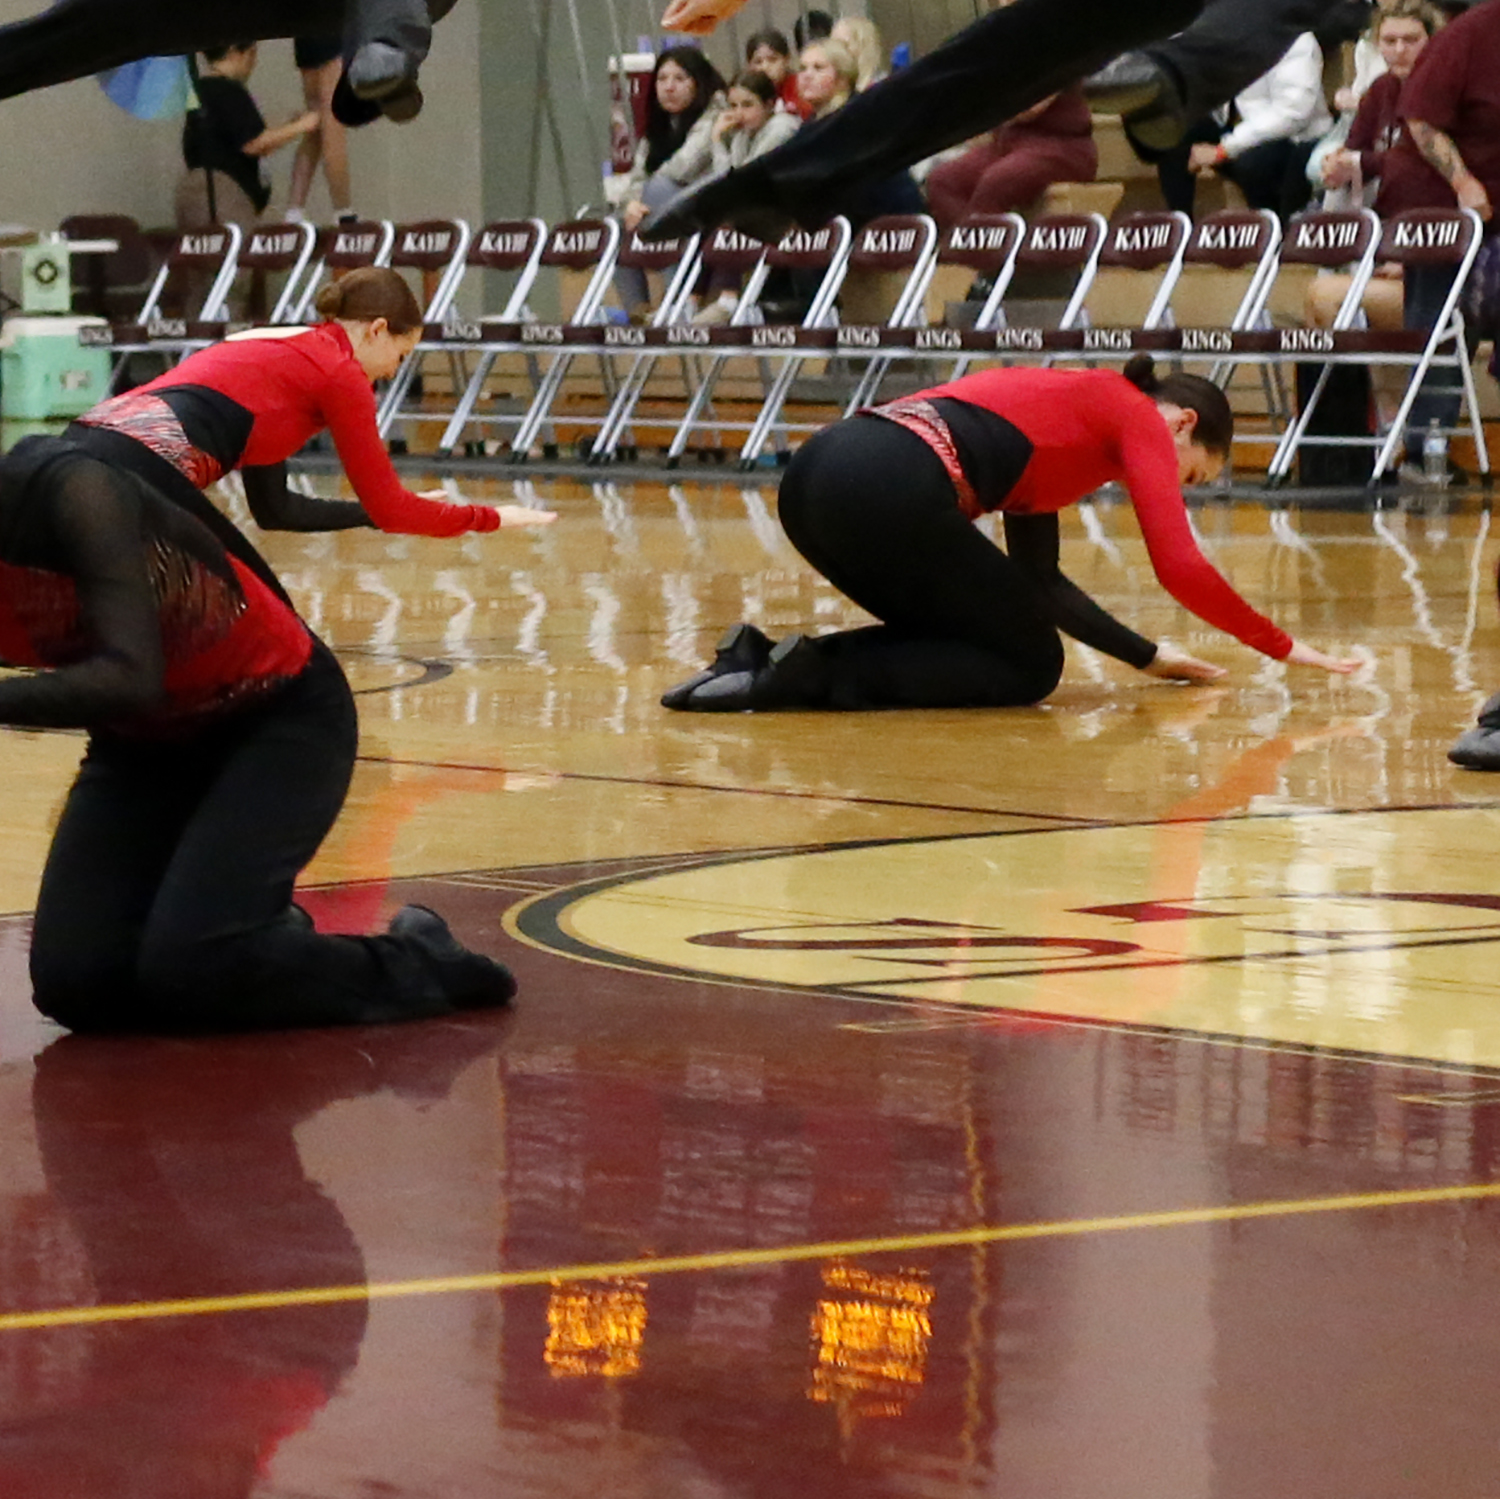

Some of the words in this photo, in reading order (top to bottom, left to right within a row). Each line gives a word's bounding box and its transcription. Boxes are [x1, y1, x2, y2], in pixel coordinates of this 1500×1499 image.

[752, 328, 796, 346] KINGS
[1084, 330, 1132, 349] KINGS
[1280, 330, 1333, 351] KINGS
